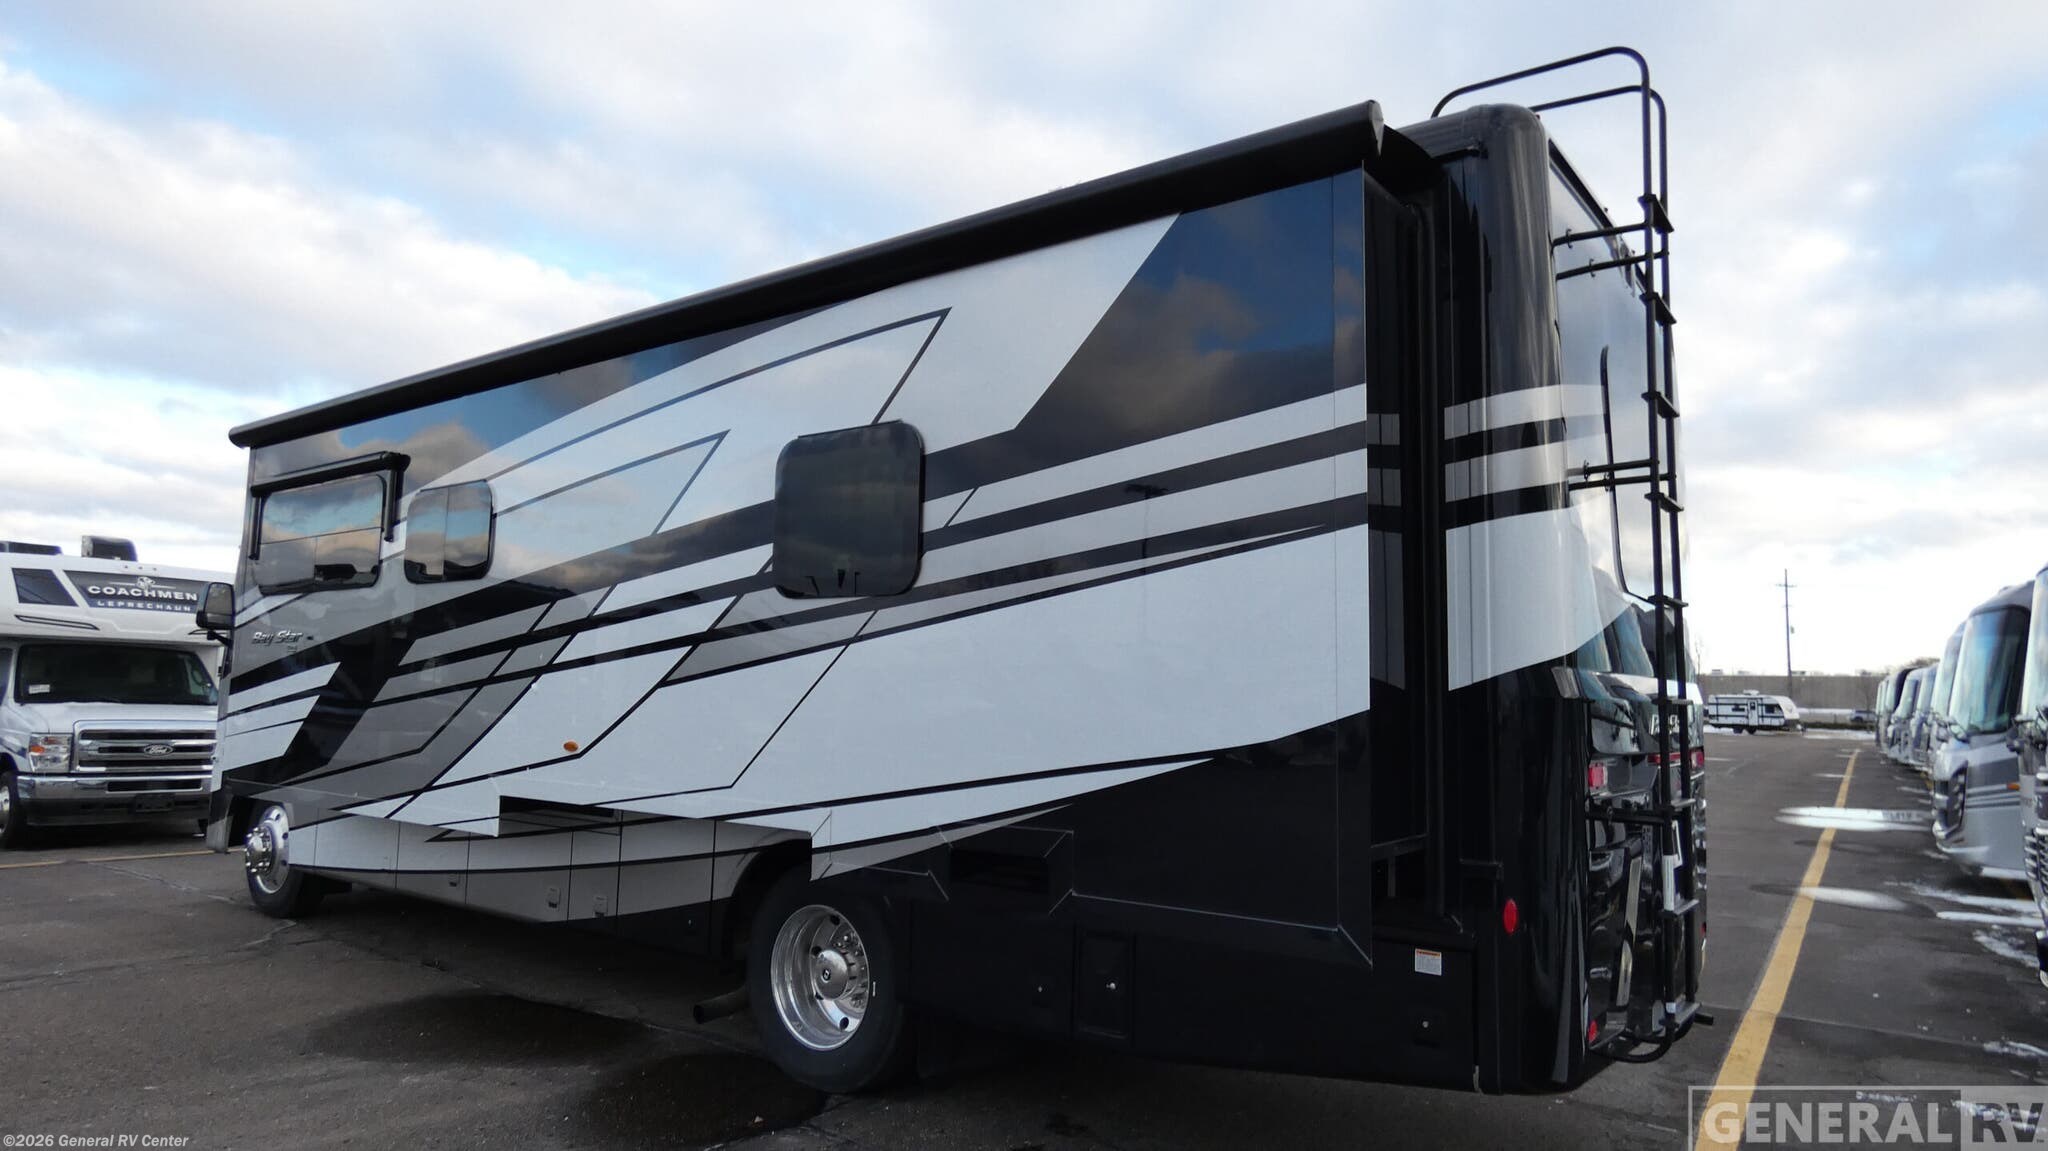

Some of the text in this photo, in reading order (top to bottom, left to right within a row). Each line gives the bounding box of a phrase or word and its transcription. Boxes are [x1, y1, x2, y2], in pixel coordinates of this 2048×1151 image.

[87, 585, 198, 601] COACHMEN
[97, 600, 191, 612] LEPRECHAUN
[276, 630, 304, 644] Star
